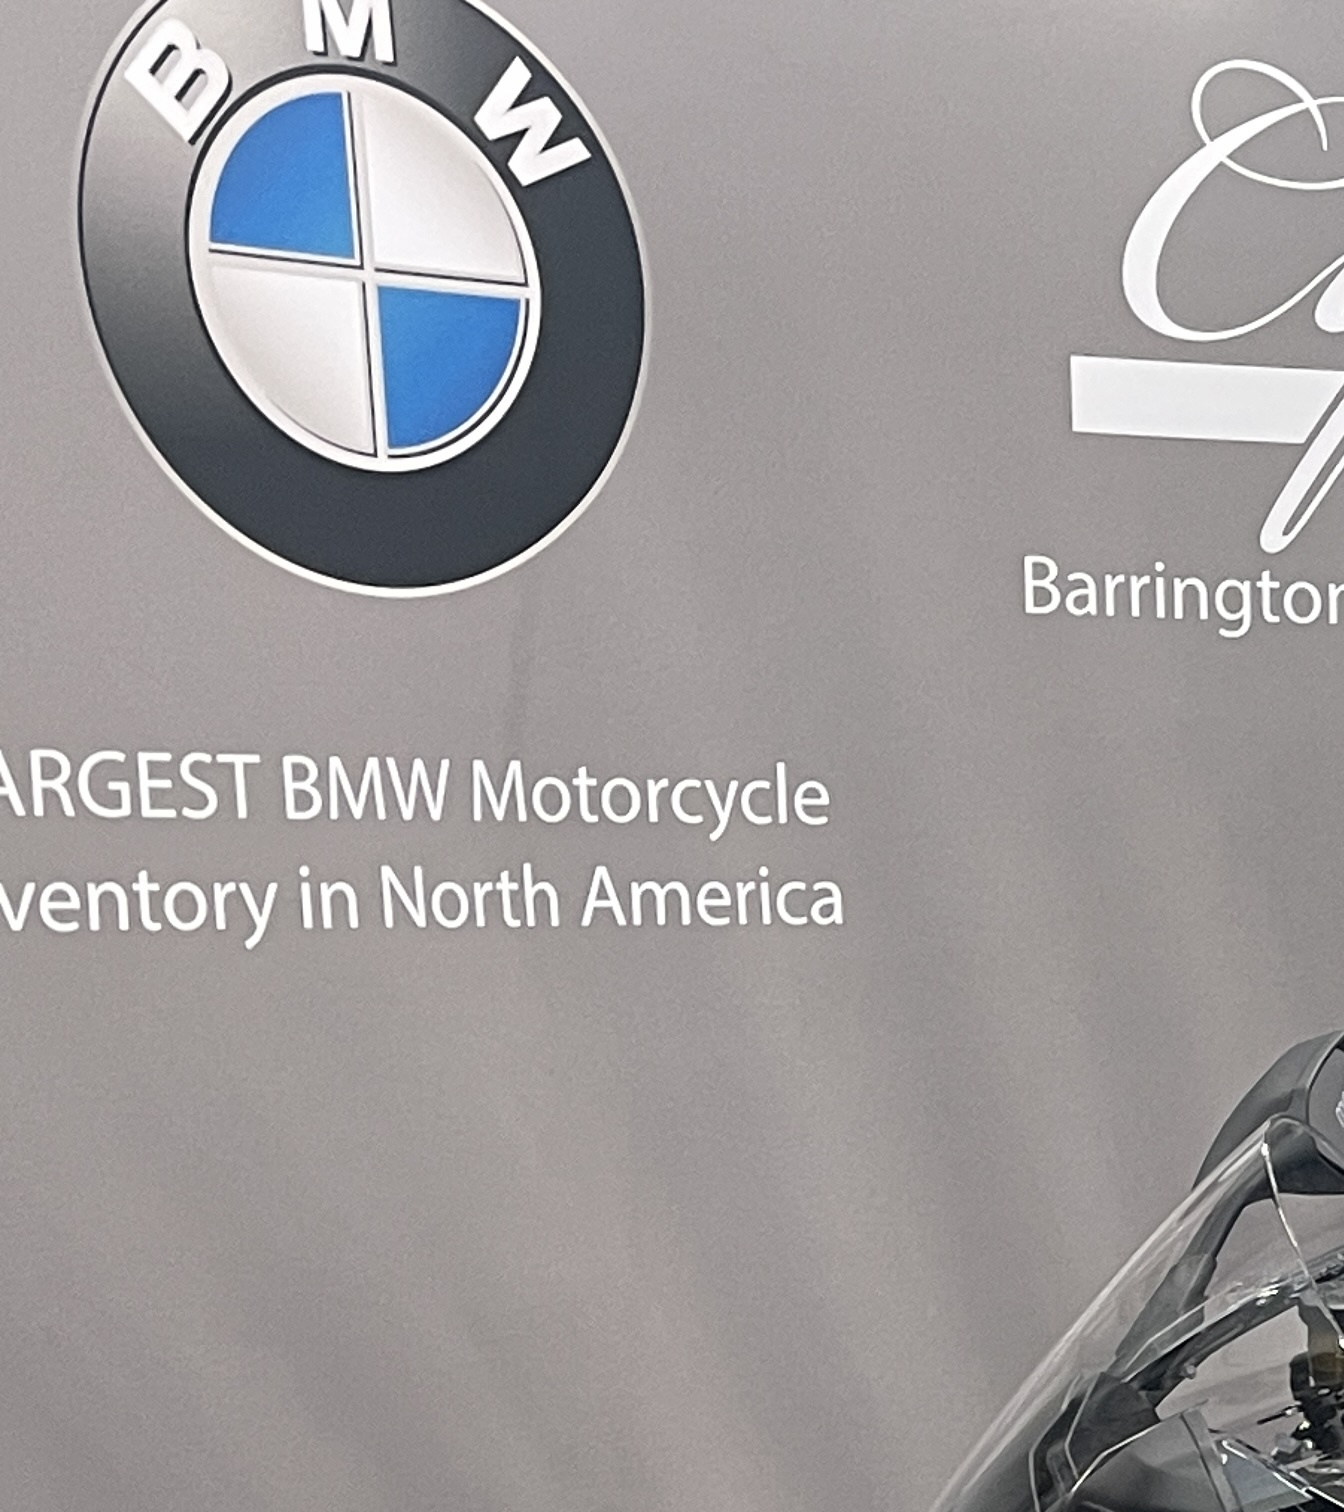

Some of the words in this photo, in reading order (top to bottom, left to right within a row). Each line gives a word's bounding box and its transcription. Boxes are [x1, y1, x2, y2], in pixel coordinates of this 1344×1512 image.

[282, 754, 450, 822] BMW
[472, 759, 830, 842] Motorcycle
[0, 869, 278, 950] ventory
[299, 865, 359, 930] in
[381, 863, 560, 930] North
[581, 866, 844, 928] America
